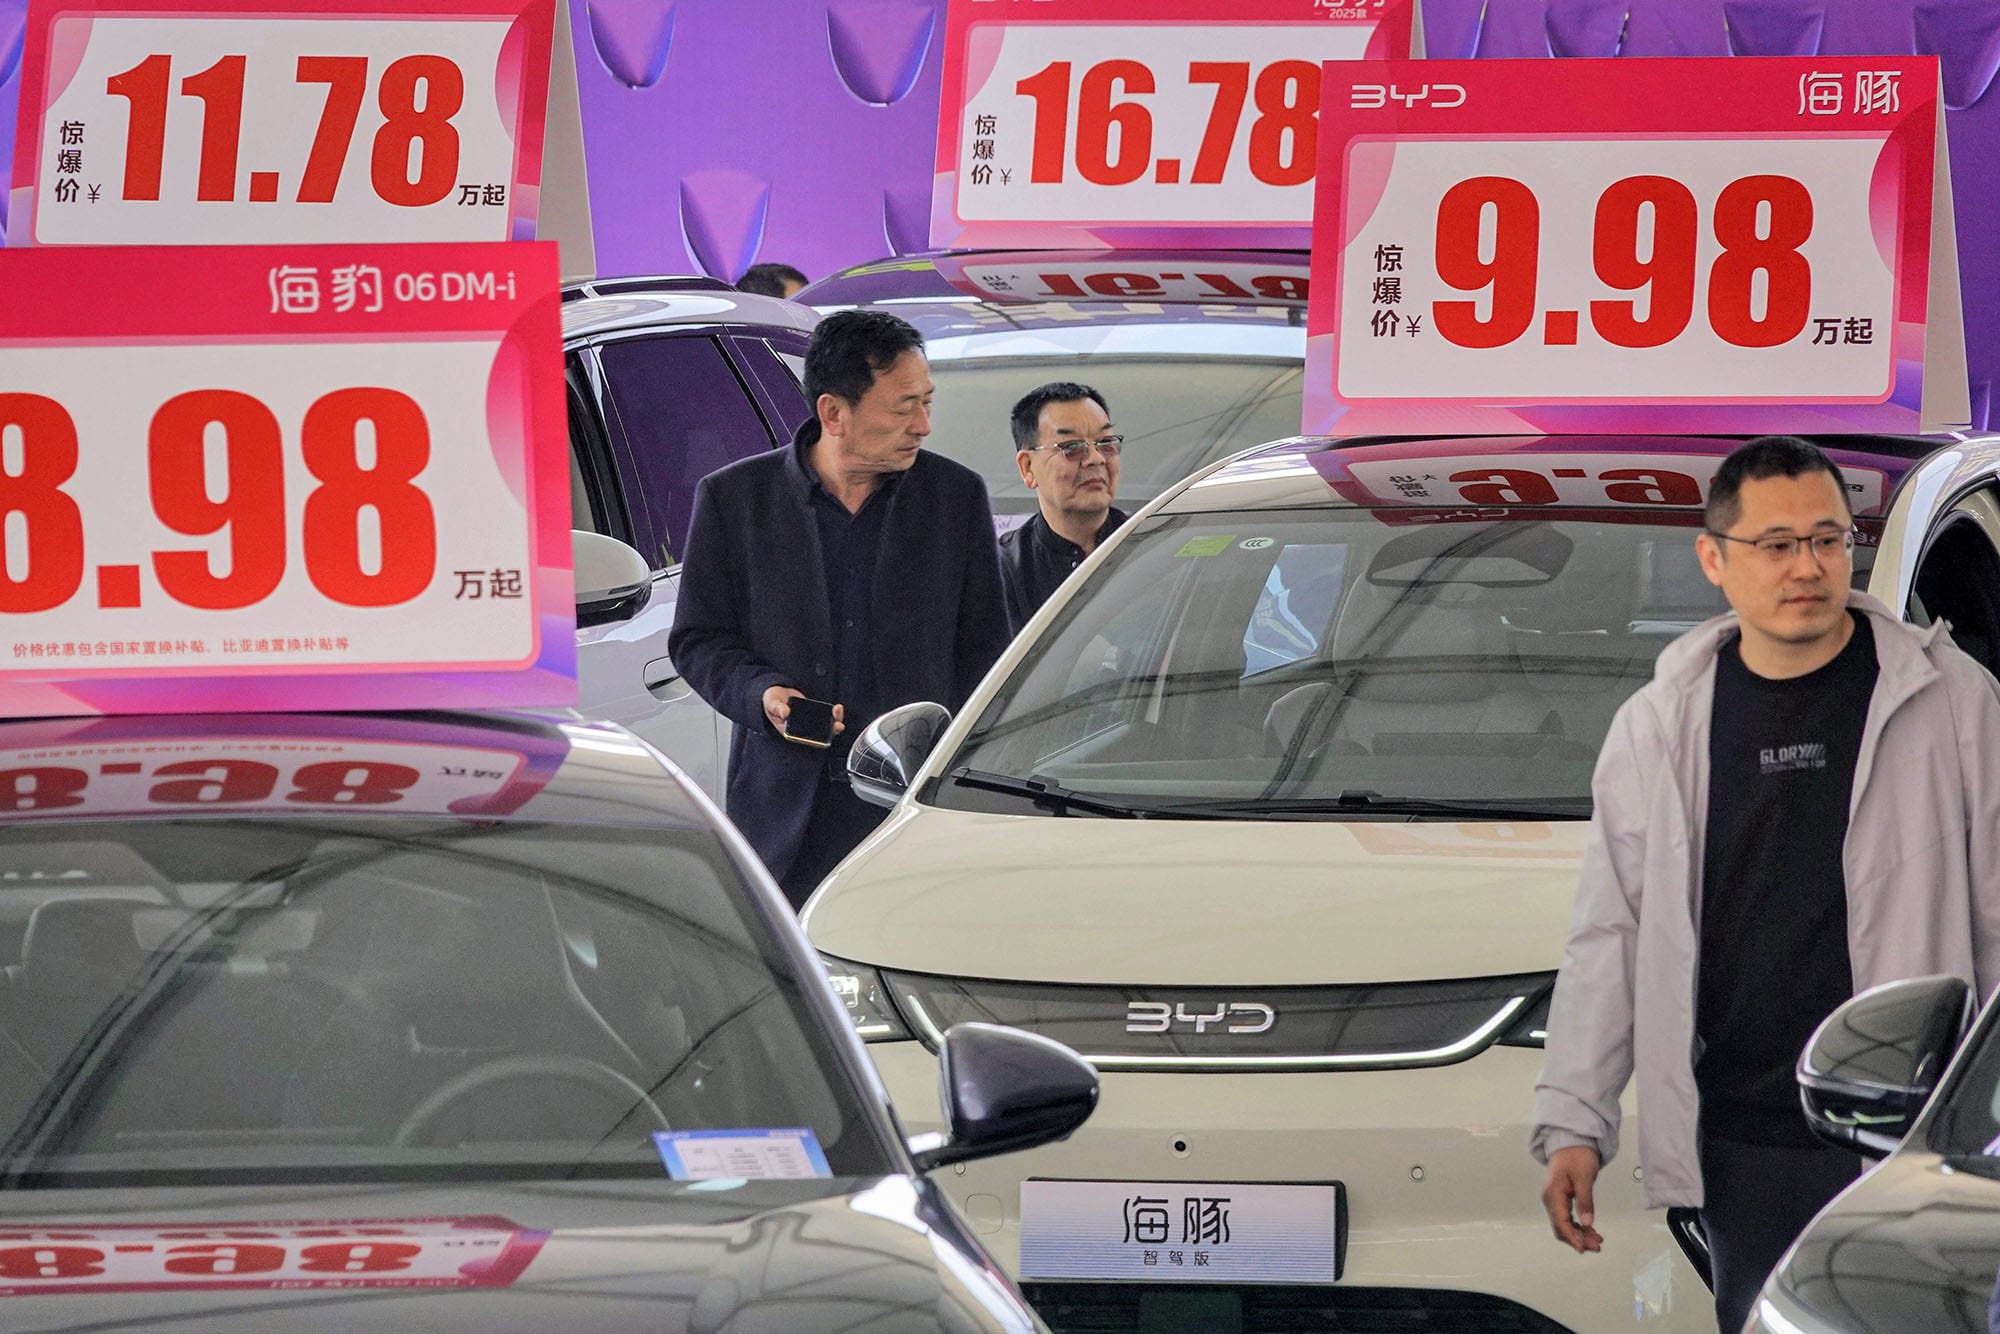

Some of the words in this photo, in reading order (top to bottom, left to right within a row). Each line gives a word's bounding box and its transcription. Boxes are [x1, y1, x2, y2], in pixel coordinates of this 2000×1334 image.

[1016, 59, 1321, 187] 16.78
[1351, 84, 1466, 108] BYD
[1798, 70, 1902, 115] 海豚
[55, 120, 85, 203] 惊爆价
[107, 54, 464, 207] 11.78
[457, 183, 505, 207] 万起
[972, 114, 997, 186] 惊爆价
[269, 264, 383, 313] 海豹
[1371, 243, 1403, 338] 惊爆价
[1433, 174, 1814, 349] 9.98
[1811, 316, 1873, 346] 万起
[0, 386, 437, 614] 8.98
[453, 568, 523, 600] 万起
[1126, 1002, 1275, 1033] BYD
[1123, 1195, 1231, 1244] 海豚
[1143, 1250, 1210, 1266] 智驾版
